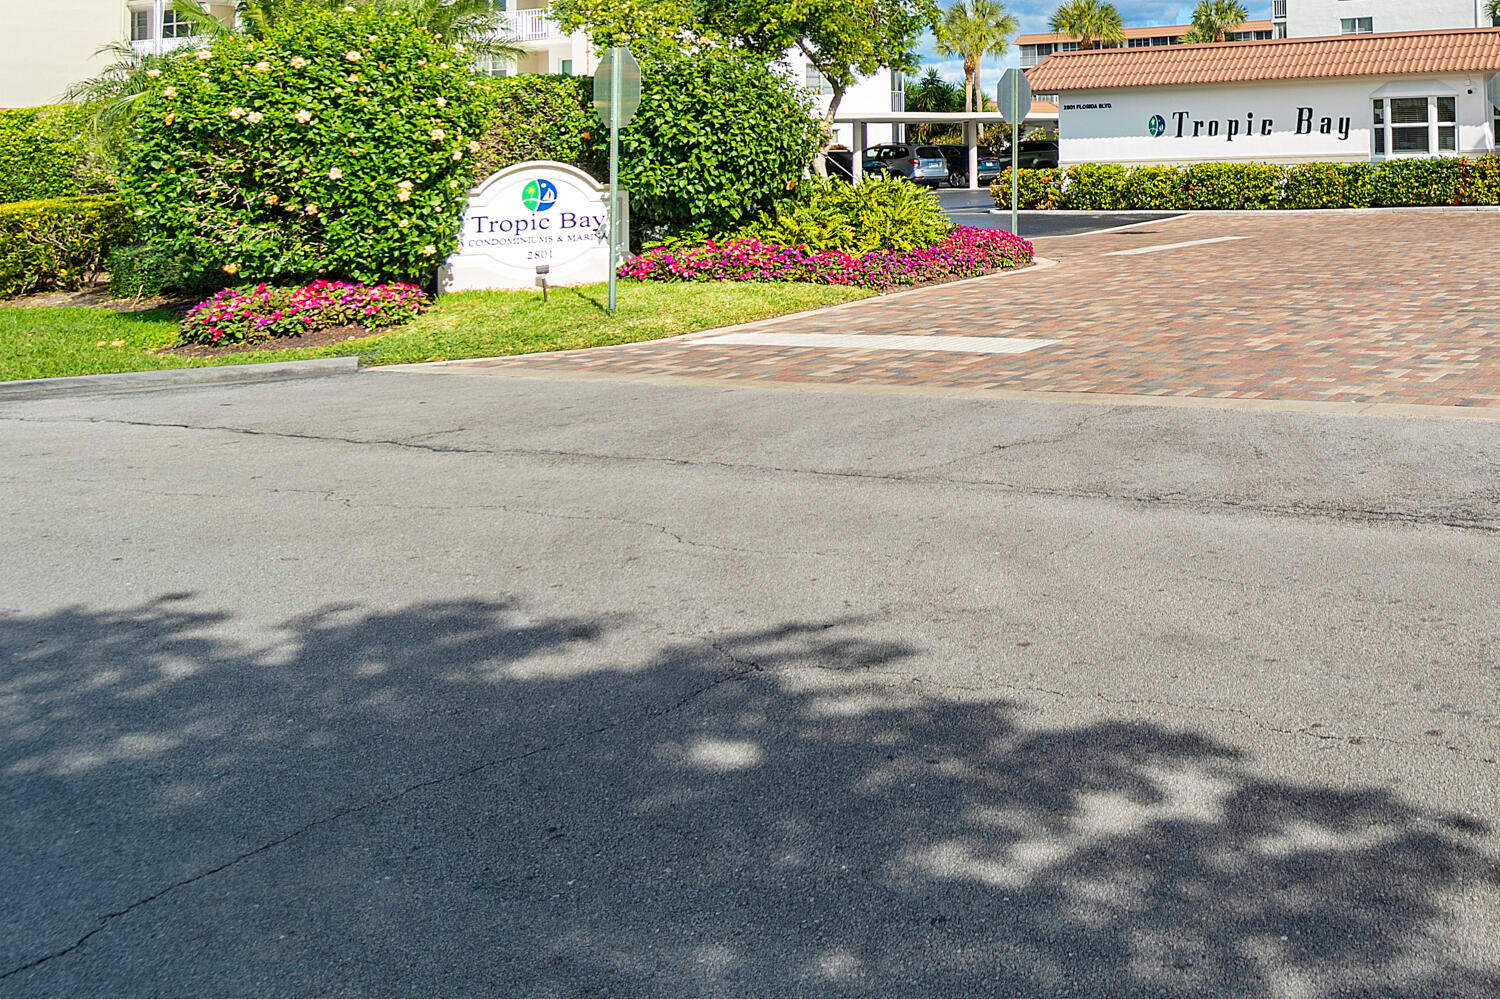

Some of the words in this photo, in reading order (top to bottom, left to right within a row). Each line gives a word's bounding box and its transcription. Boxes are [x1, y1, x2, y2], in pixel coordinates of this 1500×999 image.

[1172, 111, 1274, 142] Tropic
[1294, 107, 1350, 140] Bay
[471, 212, 550, 236] Tropic
[560, 212, 605, 232] Bay
[468, 236, 553, 247] CONDOMINIUMS
[567, 233, 608, 242] MARINA
[527, 250, 553, 260] 2801
